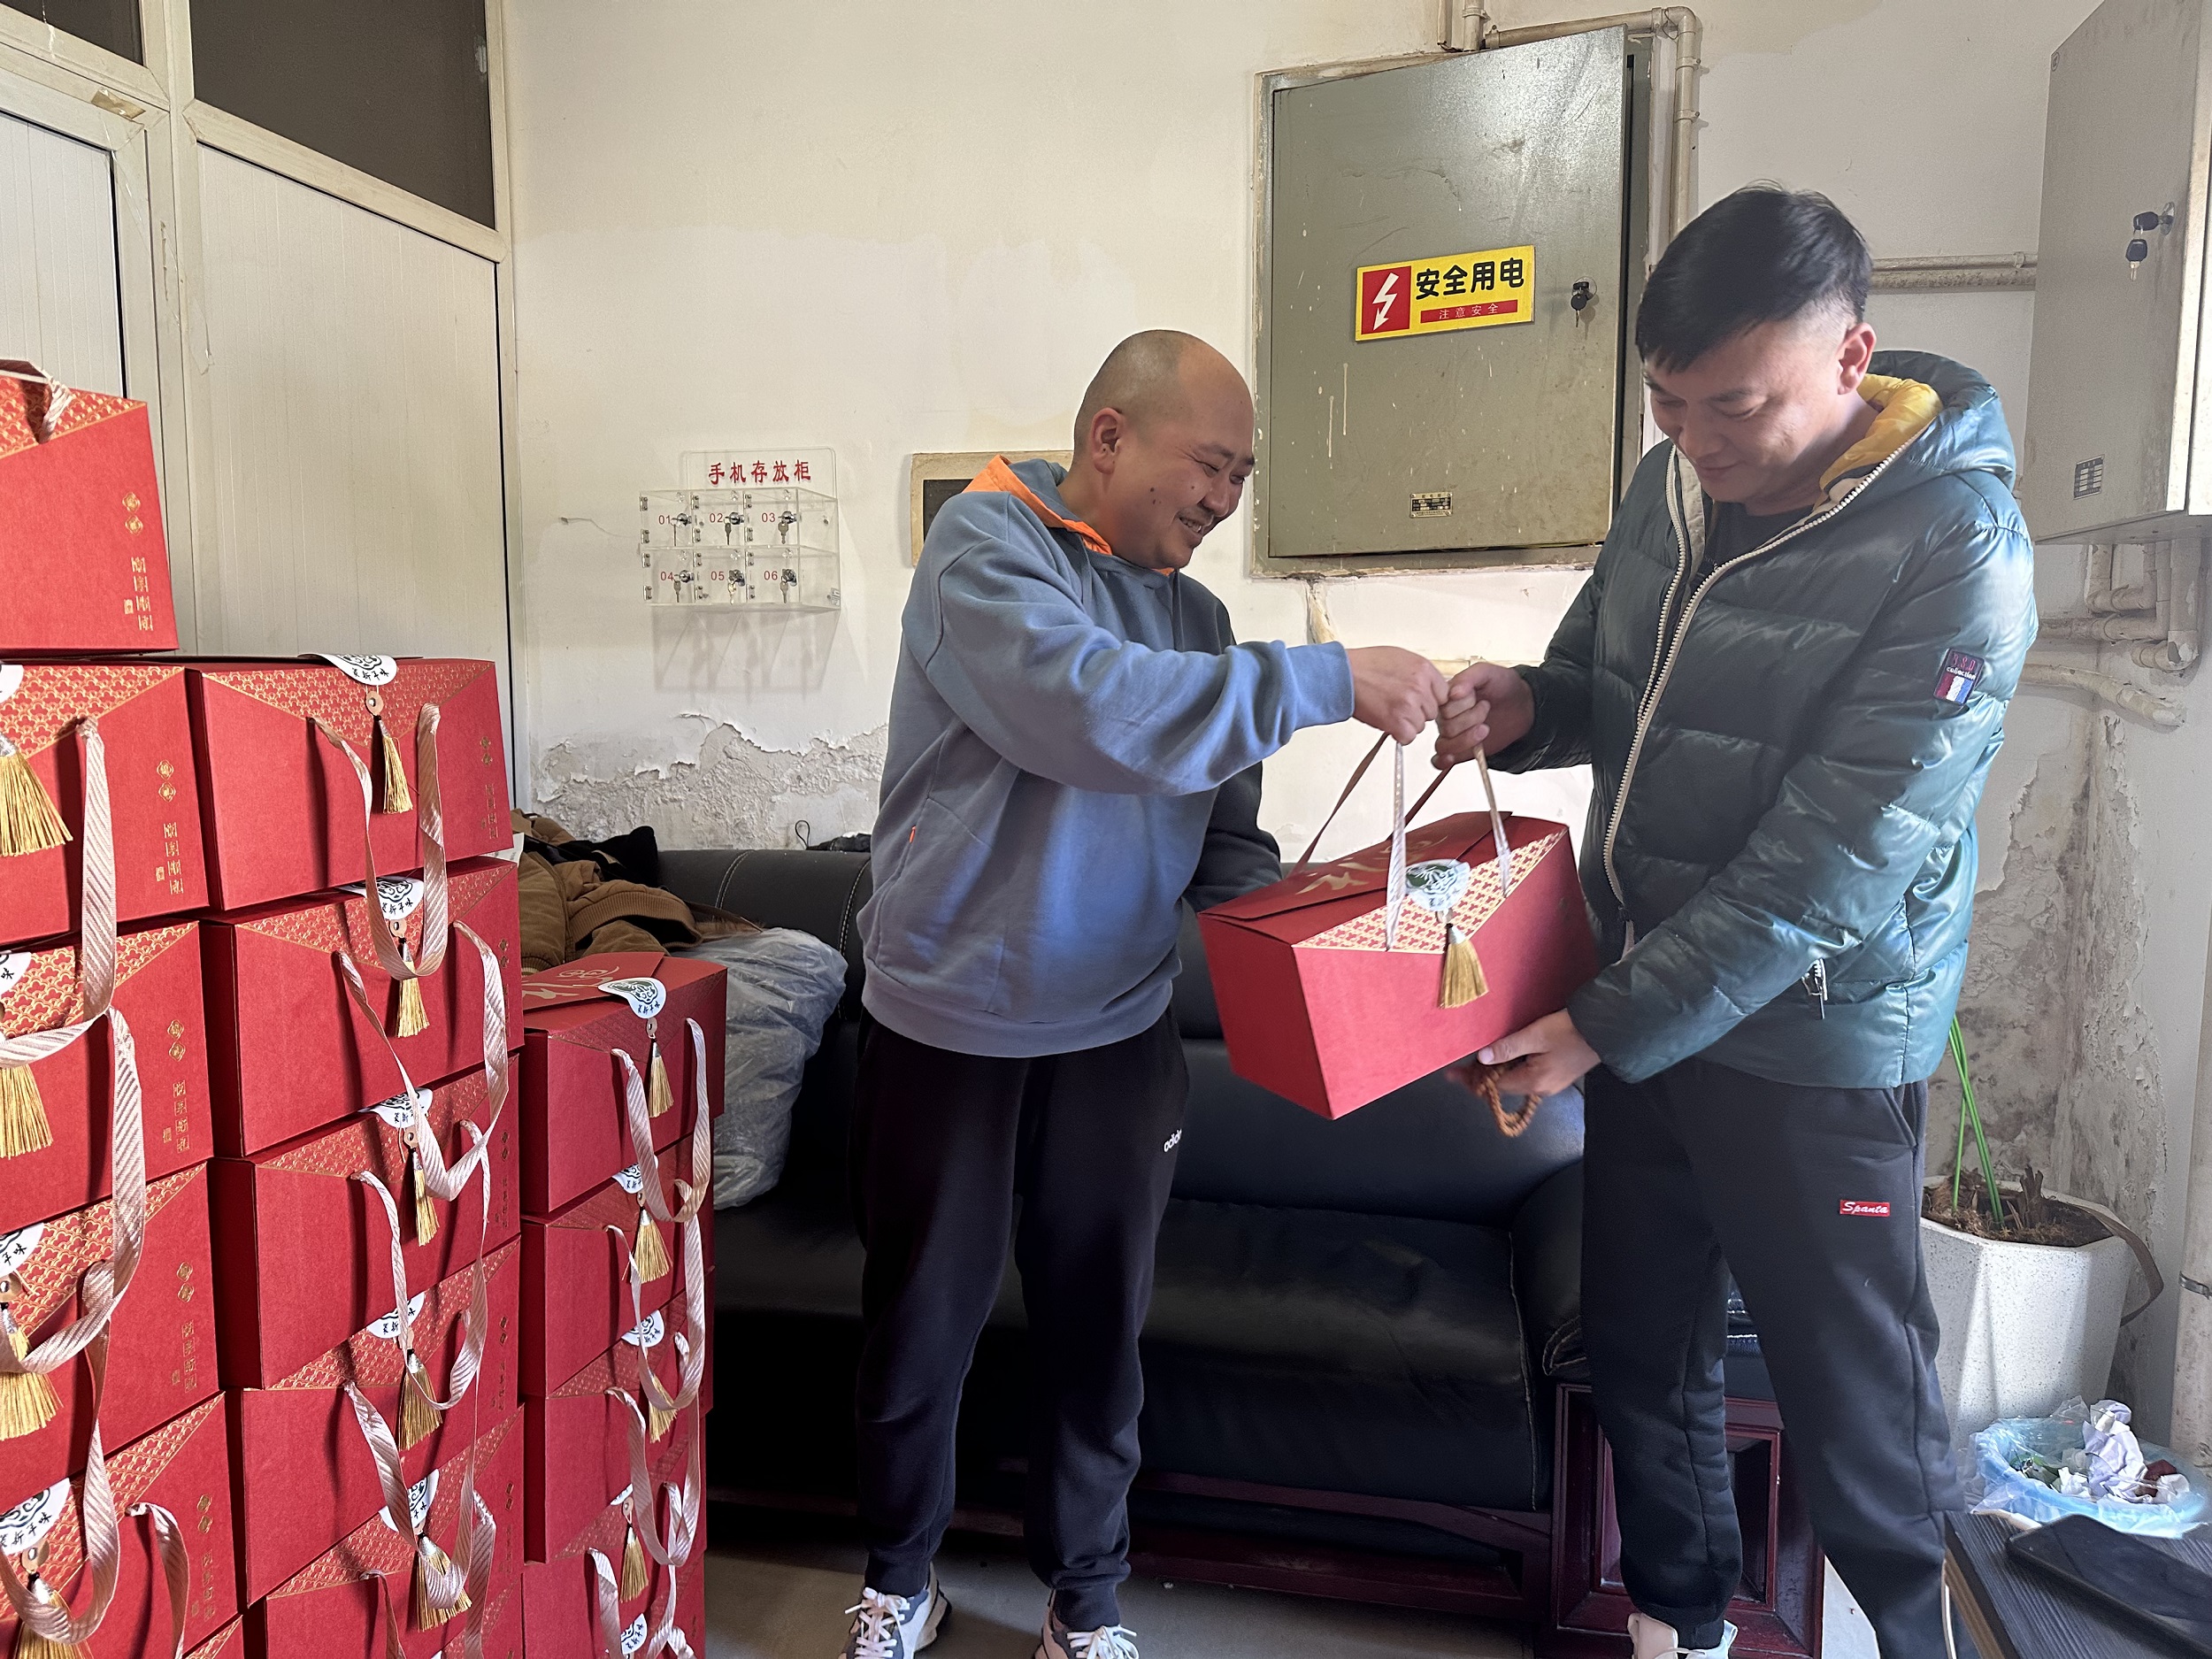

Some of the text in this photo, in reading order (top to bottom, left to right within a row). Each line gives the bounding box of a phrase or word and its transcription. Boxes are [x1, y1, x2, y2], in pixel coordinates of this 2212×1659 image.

[1416, 257, 1524, 300] 安全用电
[1439, 303, 1499, 320] 注意安全
[709, 459, 811, 485] 手机存放柜
[658, 515, 671, 525] 01
[710, 513, 723, 523] 02
[761, 513, 776, 522] 03
[710, 572, 725, 580] 05
[764, 571, 778, 580] 06
[1842, 1202, 1888, 1214] Spanta
[2, 1243, 27, 1265] 年味
